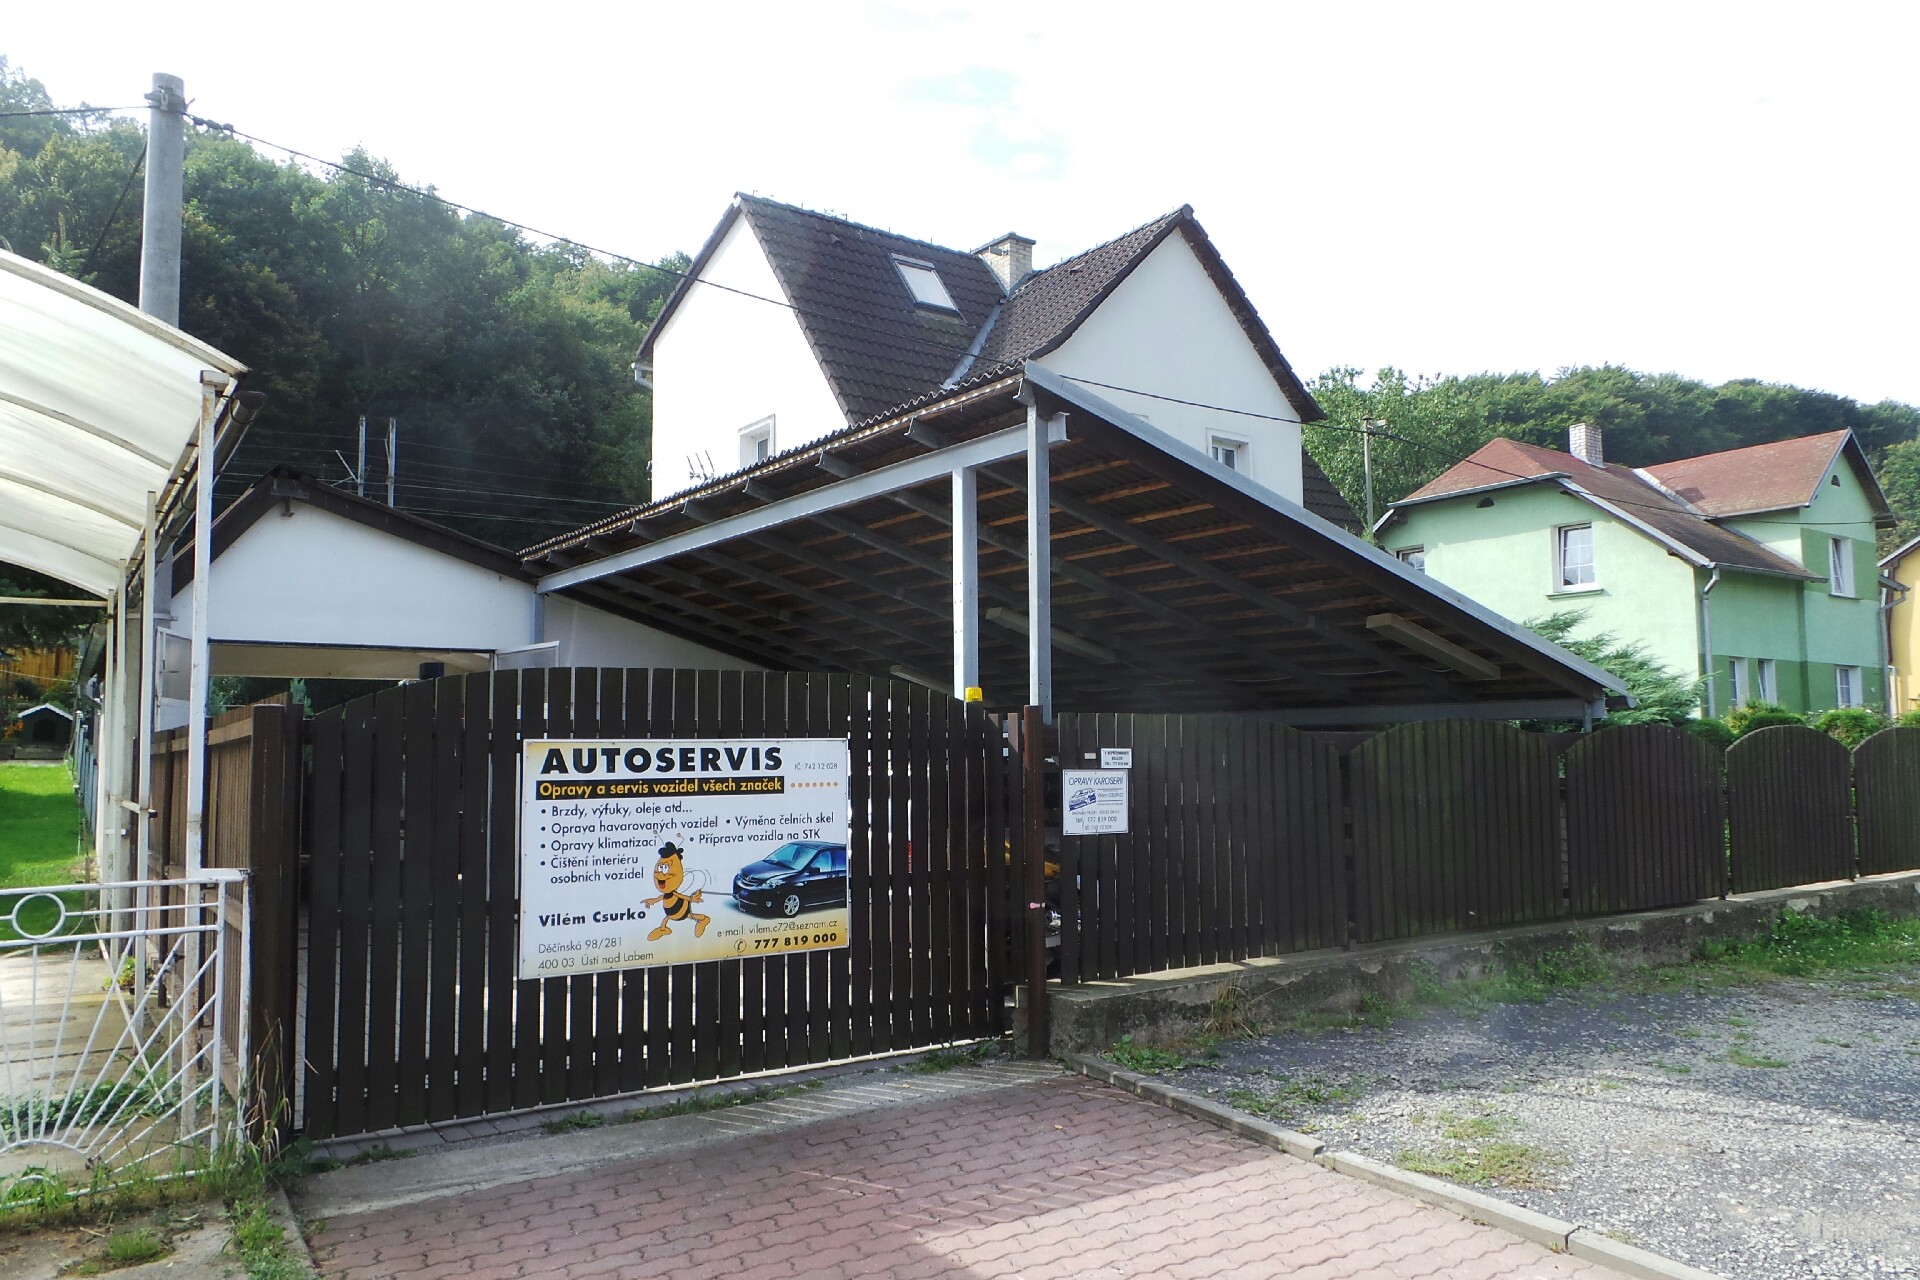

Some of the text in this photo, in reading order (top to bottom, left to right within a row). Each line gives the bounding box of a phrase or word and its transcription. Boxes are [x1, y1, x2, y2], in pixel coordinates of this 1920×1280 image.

[540, 747, 783, 774] AUTOSERVIS
[804, 762, 816, 770] 742
[818, 762, 823, 770] 12
[539, 776, 782, 798] Opravy a servis vozidel všech značek
[1069, 778, 1093, 786] OPRAVY
[552, 802, 692, 818] Brzdy, výfuky, oleje atd...
[551, 816, 718, 837] Oprava havarovaných vozidel
[735, 812, 834, 829] Výměna čelních skel
[699, 829, 820, 846] Příprava vozidla na STK
[551, 839, 594, 854] Opravy
[550, 855, 638, 868] Čištění interiéru
[550, 869, 644, 884] osobních vozidel
[539, 909, 646, 928] Vilém Csurko
[717, 926, 746, 938] e-mail:
[539, 937, 622, 954] Děčínská 98/281
[754, 933, 837, 949] 777 819 000
[539, 952, 653, 969] 400 03 Ústí nad Labem
